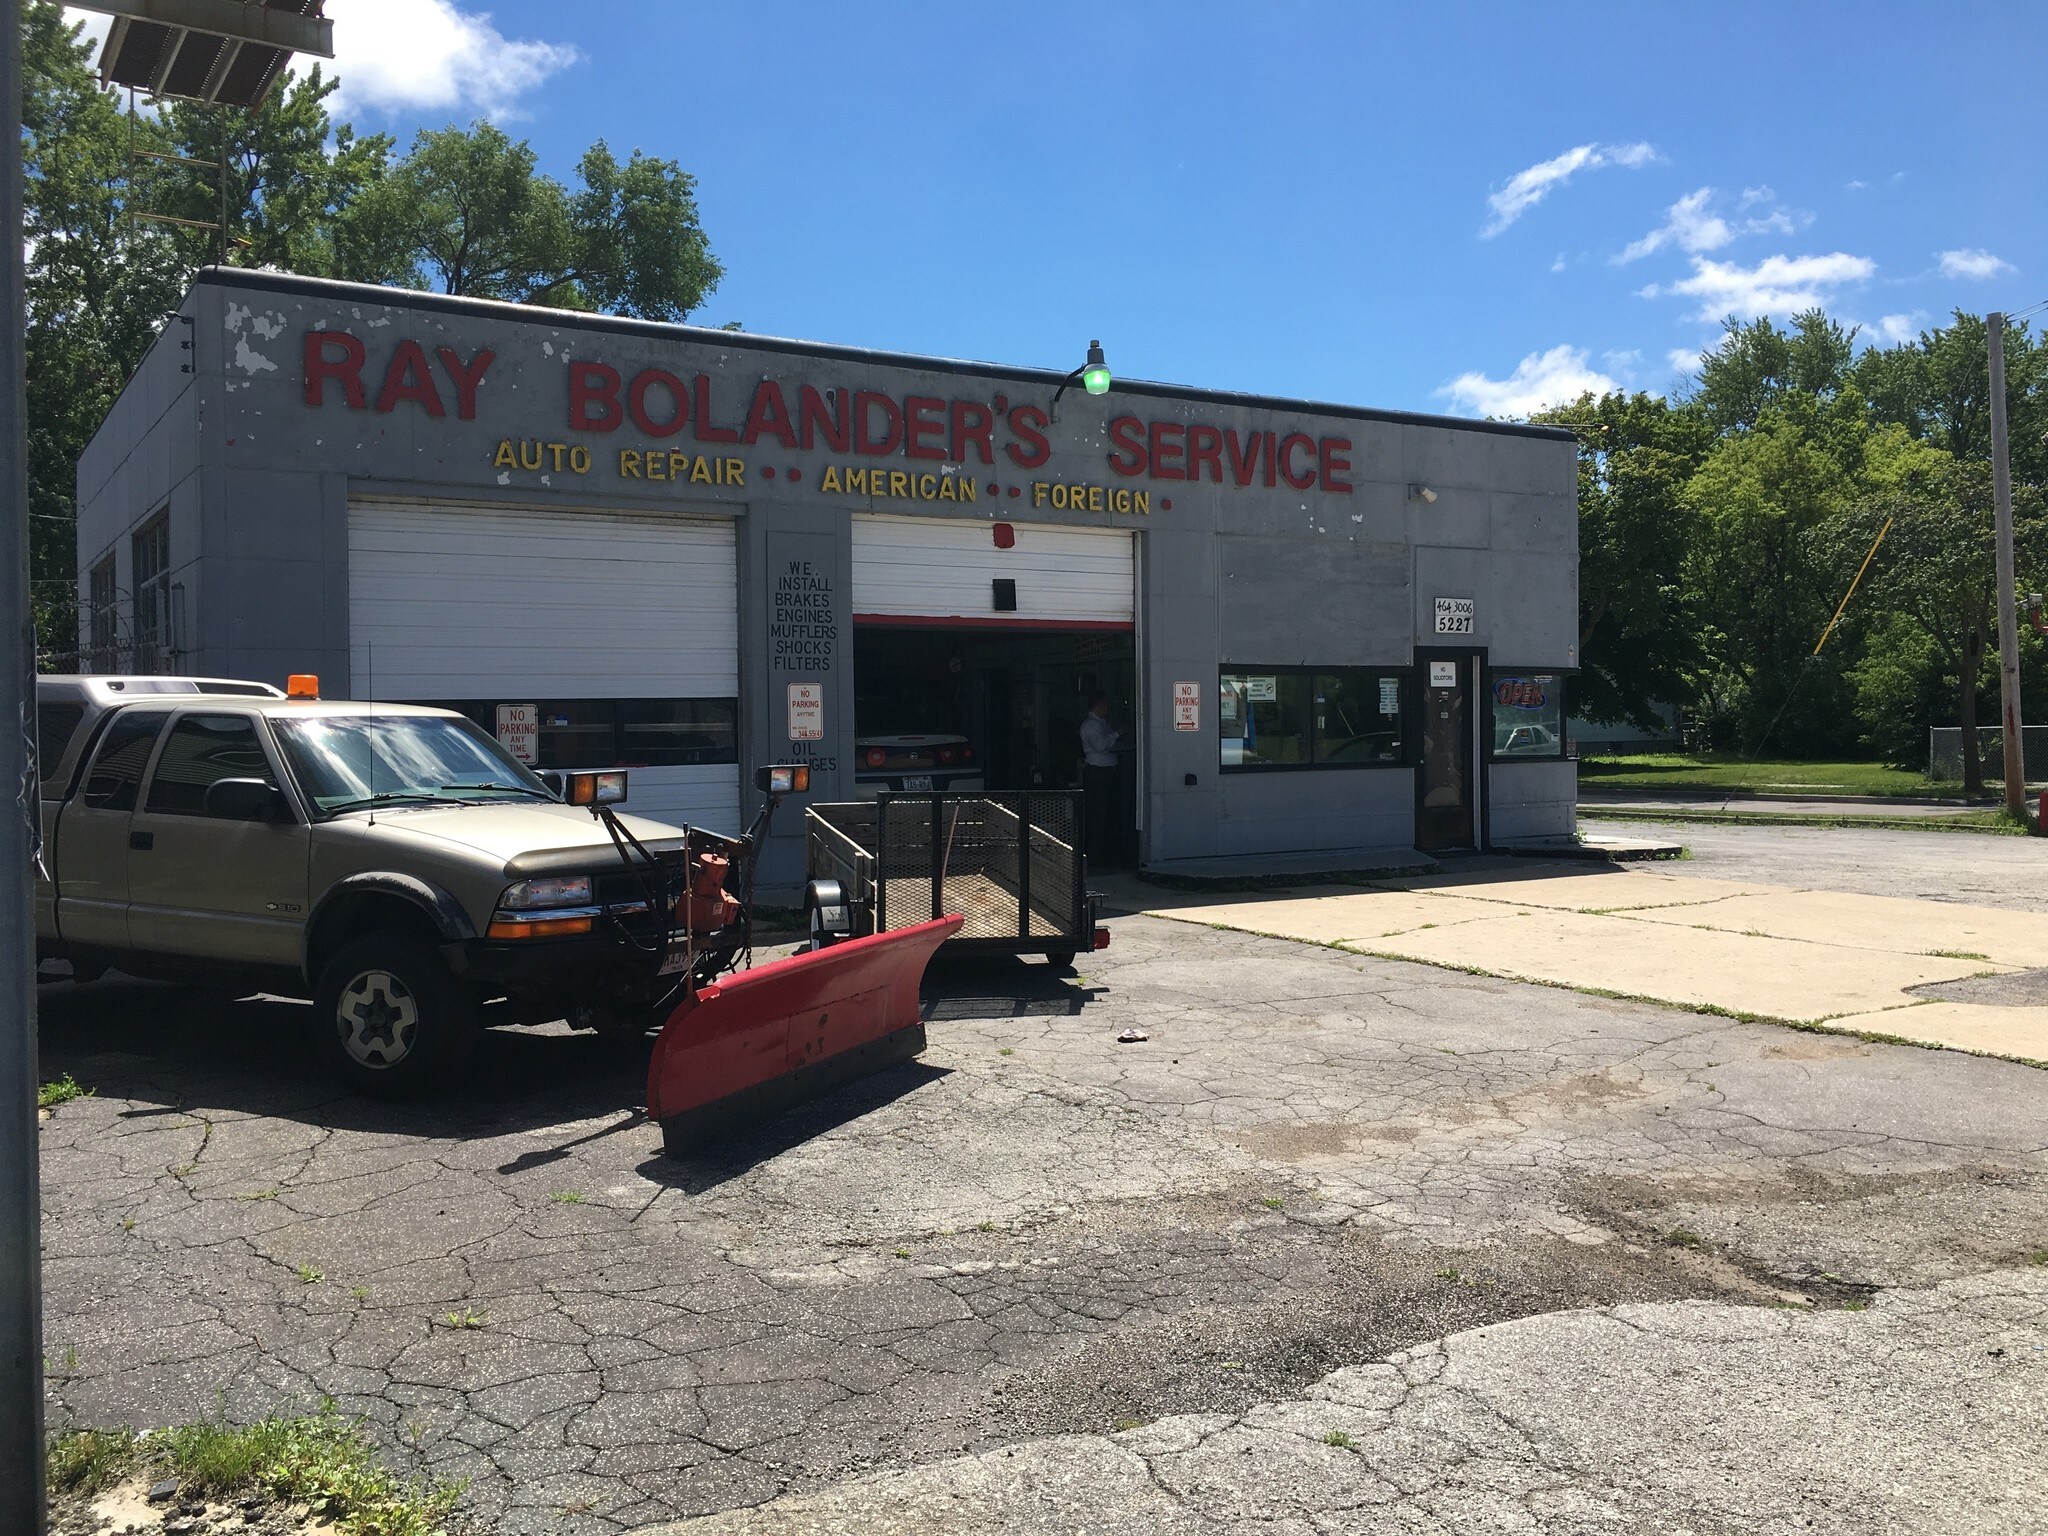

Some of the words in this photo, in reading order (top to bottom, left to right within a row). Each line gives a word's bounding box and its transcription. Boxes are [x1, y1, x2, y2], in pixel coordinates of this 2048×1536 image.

[303, 331, 497, 420] RAY
[566, 360, 1052, 469] BOLANDER'S
[1107, 415, 1354, 493] SERVICE
[493, 439, 593, 475] AUTO
[618, 448, 747, 487] REPAIR
[821, 464, 977, 503] AMERICAN
[1033, 482, 1152, 515] FOREIGN
[789, 561, 812, 576] WE
[778, 577, 833, 592] INSTALL
[775, 592, 830, 608] BRAKES
[1436, 600, 1452, 613] 464
[1453, 602, 1473, 614] 3006
[776, 608, 833, 624] ENGINES
[1438, 616, 1471, 632] 5227
[770, 624, 837, 640] MUFFLERS
[775, 640, 832, 655] SHOCKS
[774, 656, 831, 671] FILTERS
[800, 690, 810, 698] NO
[1181, 686, 1192, 696] NO
[1499, 682, 1544, 706] OPEN
[792, 700, 819, 708] PARKING
[1175, 697, 1199, 706] PARKING
[510, 710, 525, 721] NO
[500, 723, 536, 735] PARKING
[510, 735, 525, 744] ANY
[509, 744, 527, 753] TIME
[792, 742, 816, 756] OIL
